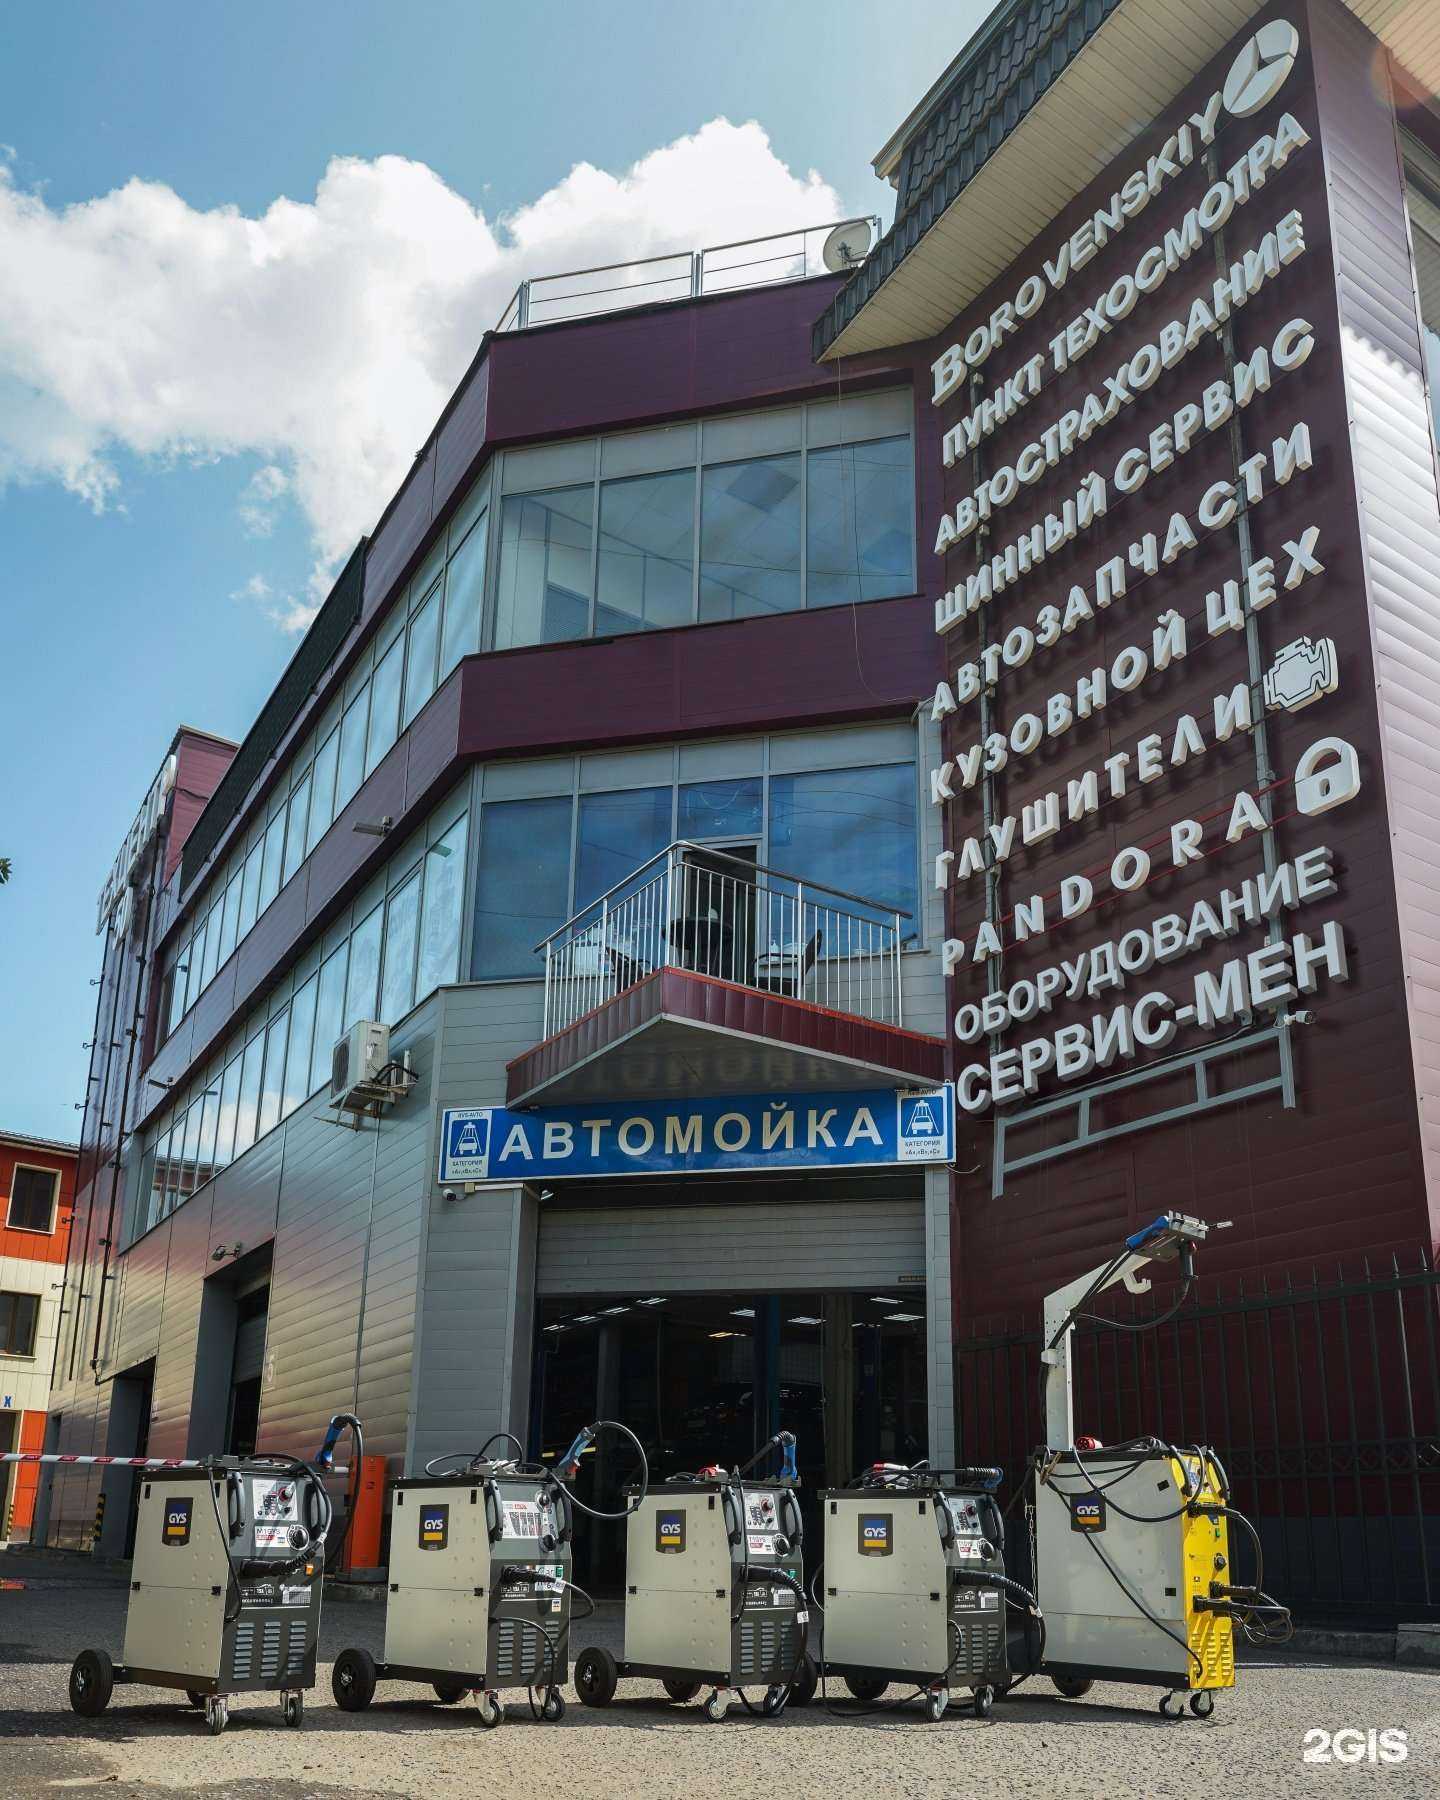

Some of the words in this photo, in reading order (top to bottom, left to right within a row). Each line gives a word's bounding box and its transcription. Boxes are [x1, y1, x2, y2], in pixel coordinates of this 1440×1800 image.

[932, 91, 1224, 406] BOROVENSKIY
[942, 353, 1045, 468] ПУНКТ
[1049, 112, 1312, 374] ТЕХОСМОТРА
[933, 208, 1306, 555] АВТОСТРАХОВАНИЕ
[935, 471, 1107, 635] ШИННЫЙ
[1114, 318, 1316, 493] СЕРВИС
[930, 421, 1313, 720] АВТОЗАПЧАСТИ
[930, 608, 1187, 806] КУЗОВНОЙ
[1205, 525, 1325, 637] ЦЕХ
[936, 683, 1251, 891] ГЛУШИТЕЛИ
[942, 791, 1267, 977] PANDORA
[954, 845, 1339, 1045] ОБОРУДОВАНИЕ
[956, 920, 1350, 1115] СЕРВИС-МЕН
[498, 1101, 884, 1162] АВТОМОЙКА
[169, 1512, 187, 1524] GYS
[424, 1519, 443, 1530] GYS
[661, 1523, 681, 1534] GYS
[864, 1527, 887, 1538] GYS
[1076, 1505, 1100, 1515] GYS
